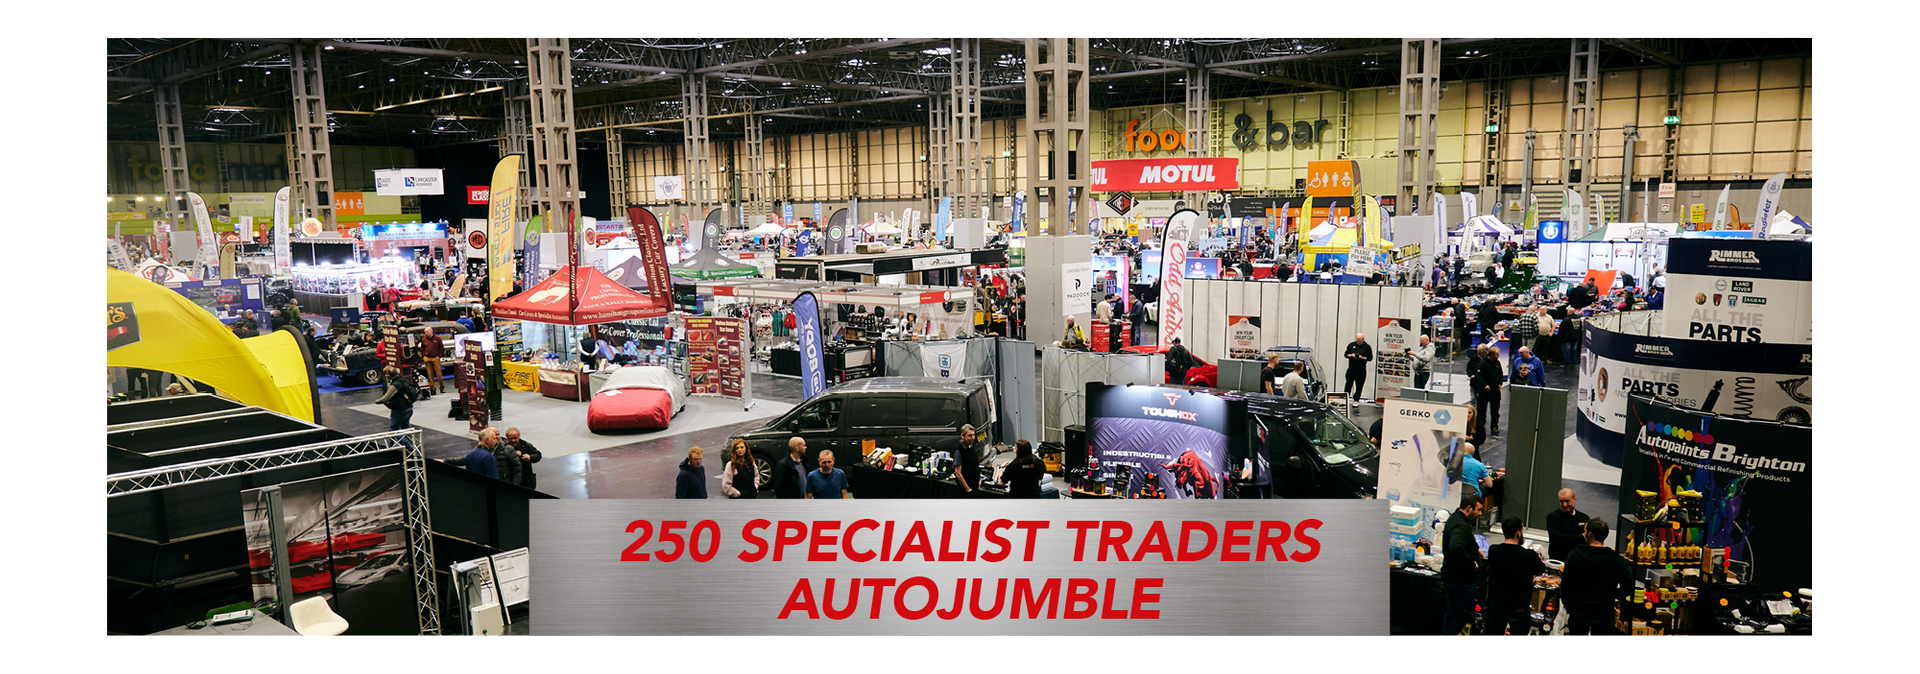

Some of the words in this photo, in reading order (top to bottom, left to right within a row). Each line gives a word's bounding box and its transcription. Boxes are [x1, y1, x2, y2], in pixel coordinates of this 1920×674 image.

[1232, 114, 1259, 147] &
[1267, 110, 1328, 145] bar
[128, 154, 210, 181] fod
[1140, 164, 1216, 185] MOTUL
[1758, 198, 1772, 239] Register
[638, 223, 646, 236] Ltd
[648, 224, 658, 250] Covers
[642, 237, 654, 264] Classic
[654, 251, 662, 264] Car
[1709, 250, 1760, 263] RIMMER
[1169, 242, 1186, 288] Odd
[648, 264, 661, 298] Hamilton
[658, 266, 669, 292] Luxury
[1691, 308, 1722, 322] ALL
[1728, 311, 1764, 327] THE
[609, 327, 626, 336] Cover
[626, 329, 665, 341] Professionals
[1689, 322, 1762, 344] PARTS
[804, 317, 819, 372] BODY
[1635, 344, 1673, 355] RIMMER
[1623, 367, 1645, 379] ALL
[1651, 370, 1680, 383] THE
[1622, 378, 1679, 397] PARTS
[1141, 407, 1198, 422] TOUGHOX
[1400, 408, 1431, 418] GERKO
[1103, 450, 1172, 460] INDESTRUCTIBLE
[1635, 425, 1710, 459] Autopaints
[1712, 442, 1806, 472] Brighton
[1680, 459, 1716, 470] Commercial
[1717, 466, 1755, 478] Refinishing
[1756, 473, 1790, 482] Products
